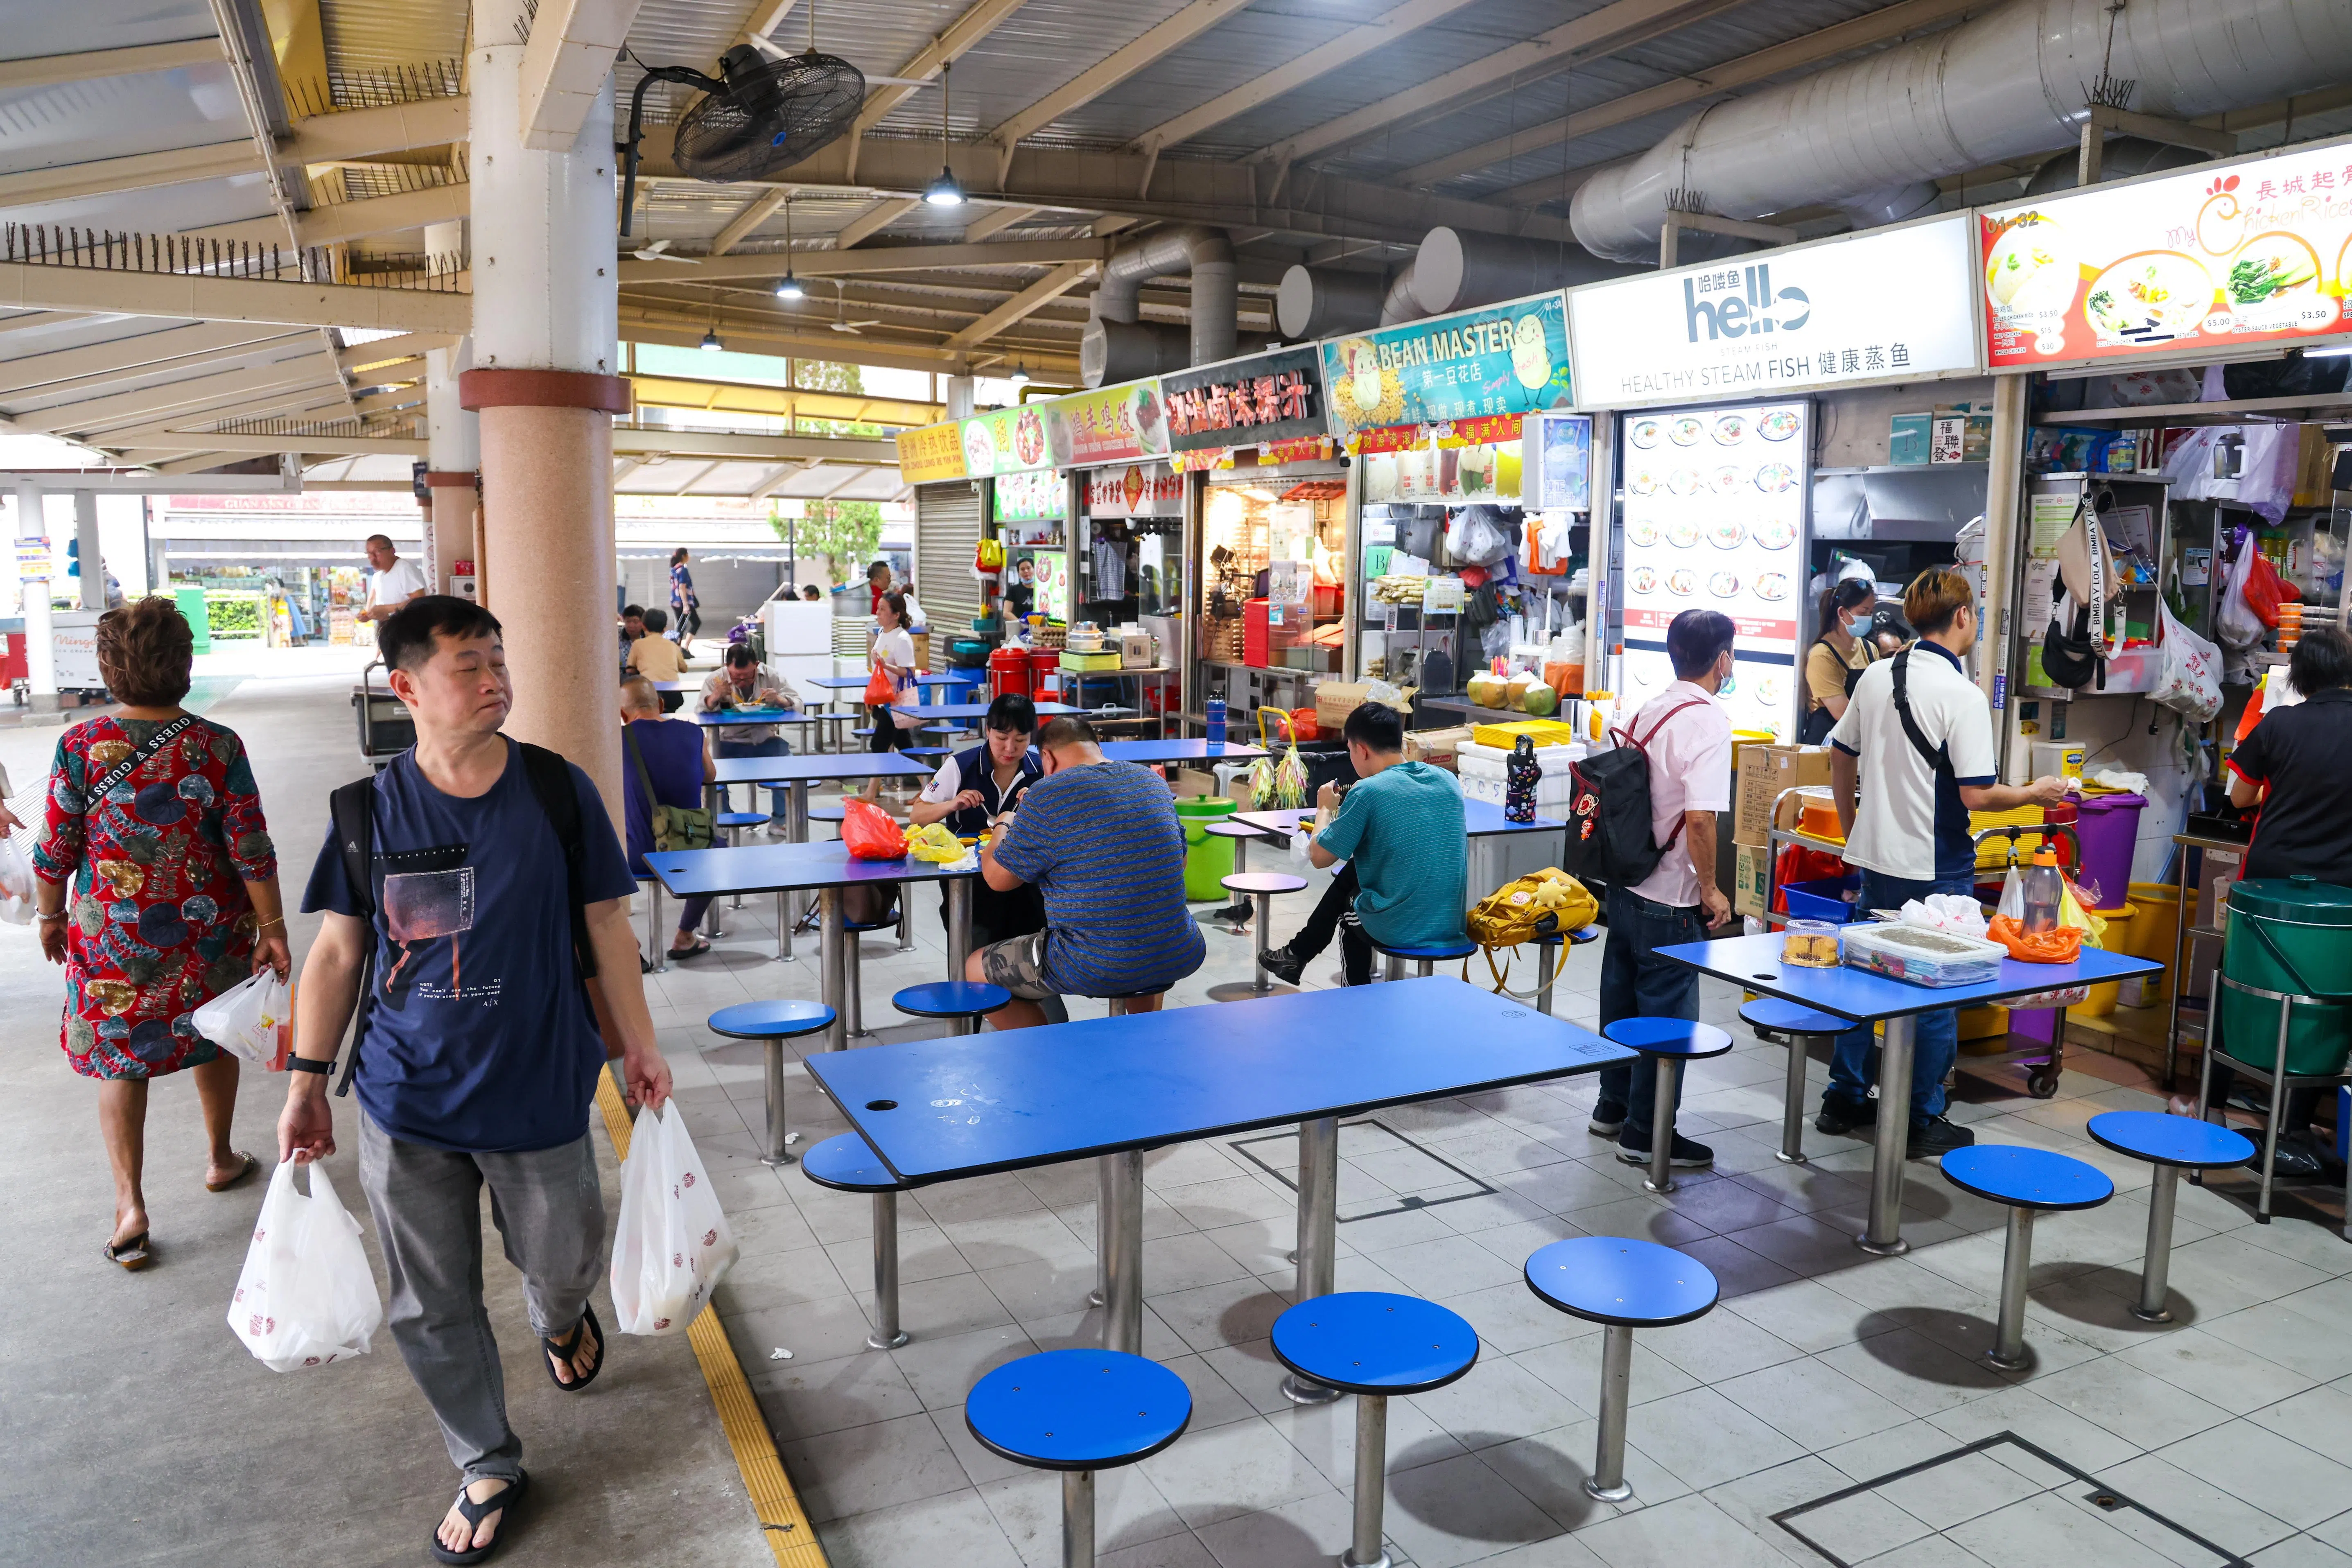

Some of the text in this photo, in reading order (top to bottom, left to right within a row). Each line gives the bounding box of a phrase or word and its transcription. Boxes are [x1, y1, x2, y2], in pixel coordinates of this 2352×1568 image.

[1986, 210, 2039, 233] 01-32
[1698, 270, 1740, 293] 哈喽鱼
[1545, 299, 1562, 311] 01-34
[1683, 264, 1810, 343] hello
[1993, 305, 2013, 314] 白鸡饭
[2039, 310, 2058, 318] $3.50
[2301, 310, 2326, 319] $3.50
[2208, 318, 2230, 327] $5.00
[1380, 320, 1515, 371] BEAN MASTER
[1721, 342, 1778, 357] STEAM FISH
[1819, 342, 1911, 374] 健康蒸鱼
[1422, 363, 1482, 389] 第一豆花店
[1483, 352, 1538, 395] Simply fresh
[1622, 357, 1810, 393] HEALTHY STEAM FISH
[1364, 431, 1411, 449] 财源滚滚
[1466, 420, 1522, 440] 福满人间
[1376, 554, 1385, 569] B
[149, 717, 190, 749] GUESS
[94, 761, 132, 796] GUESS
